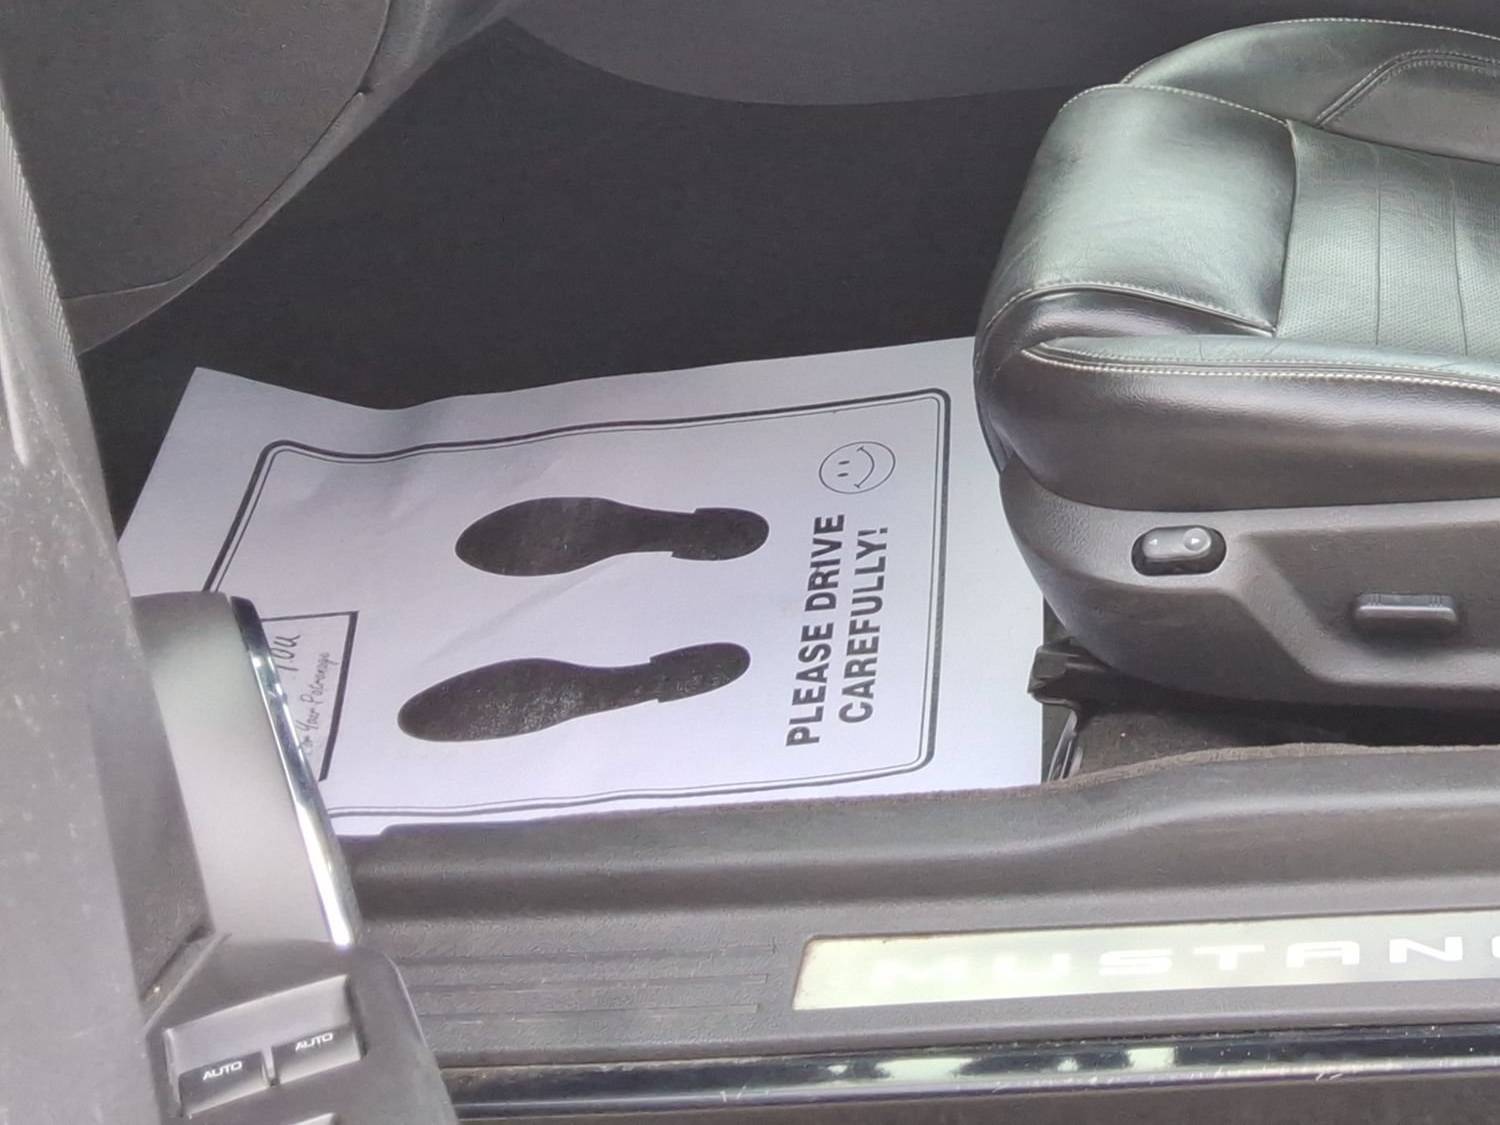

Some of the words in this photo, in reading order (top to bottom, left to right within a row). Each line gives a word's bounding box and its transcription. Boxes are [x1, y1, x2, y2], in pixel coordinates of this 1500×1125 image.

[804, 514, 845, 612] DRIVE
[838, 527, 888, 724] CAREFULLY!
[786, 622, 834, 747] PLEASE
[202, 1060, 243, 1081] AUTO
[294, 1032, 334, 1052] AUTO
